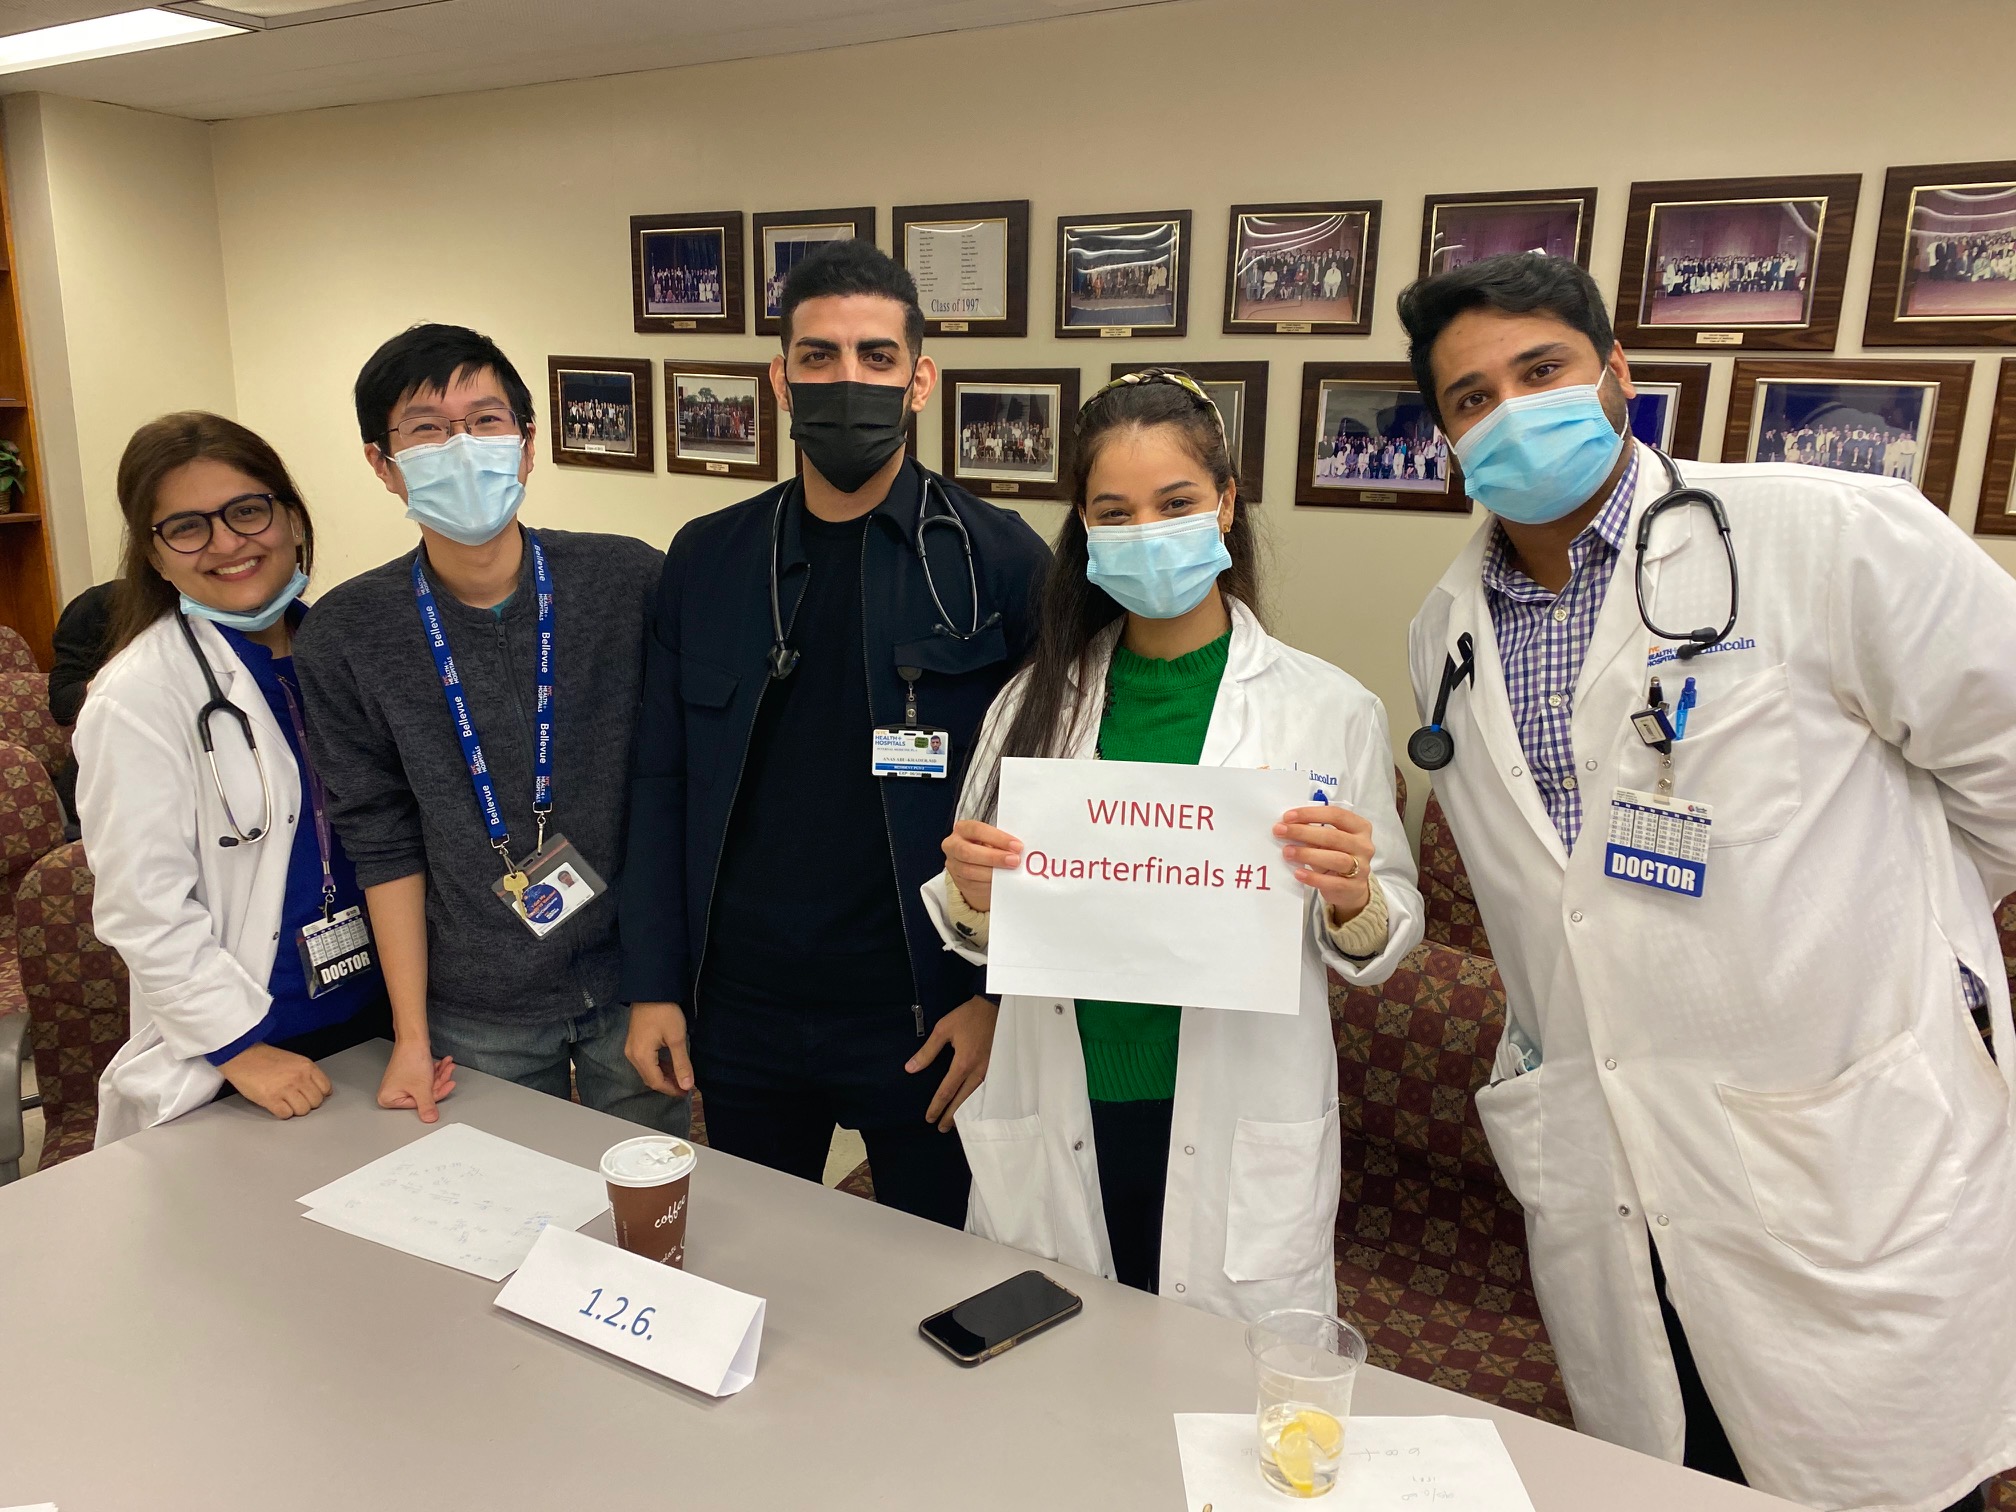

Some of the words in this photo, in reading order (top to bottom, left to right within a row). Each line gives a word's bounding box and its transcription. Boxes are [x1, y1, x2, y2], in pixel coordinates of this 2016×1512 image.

[931, 299, 950, 312] Class
[952, 299, 960, 312] of
[962, 298, 979, 312] 1997
[534, 545, 545, 581] Bellevue
[426, 605, 445, 648] Bellevue
[541, 632, 551, 673] Bellevue
[454, 696, 473, 738] Bellevue
[539, 723, 550, 764] Bellevue
[1309, 769, 1338, 786] incoln
[482, 785, 500, 826] Bellevue
[1087, 798, 1215, 831] WINNER
[1025, 850, 1225, 888] Quarterfinals
[1234, 863, 1272, 891] #1
[1611, 852, 1696, 892] DOCTOR
[320, 951, 371, 984] DOCTOR
[654, 1194, 686, 1229] coffee
[578, 1288, 657, 1341] 1.2.6.
